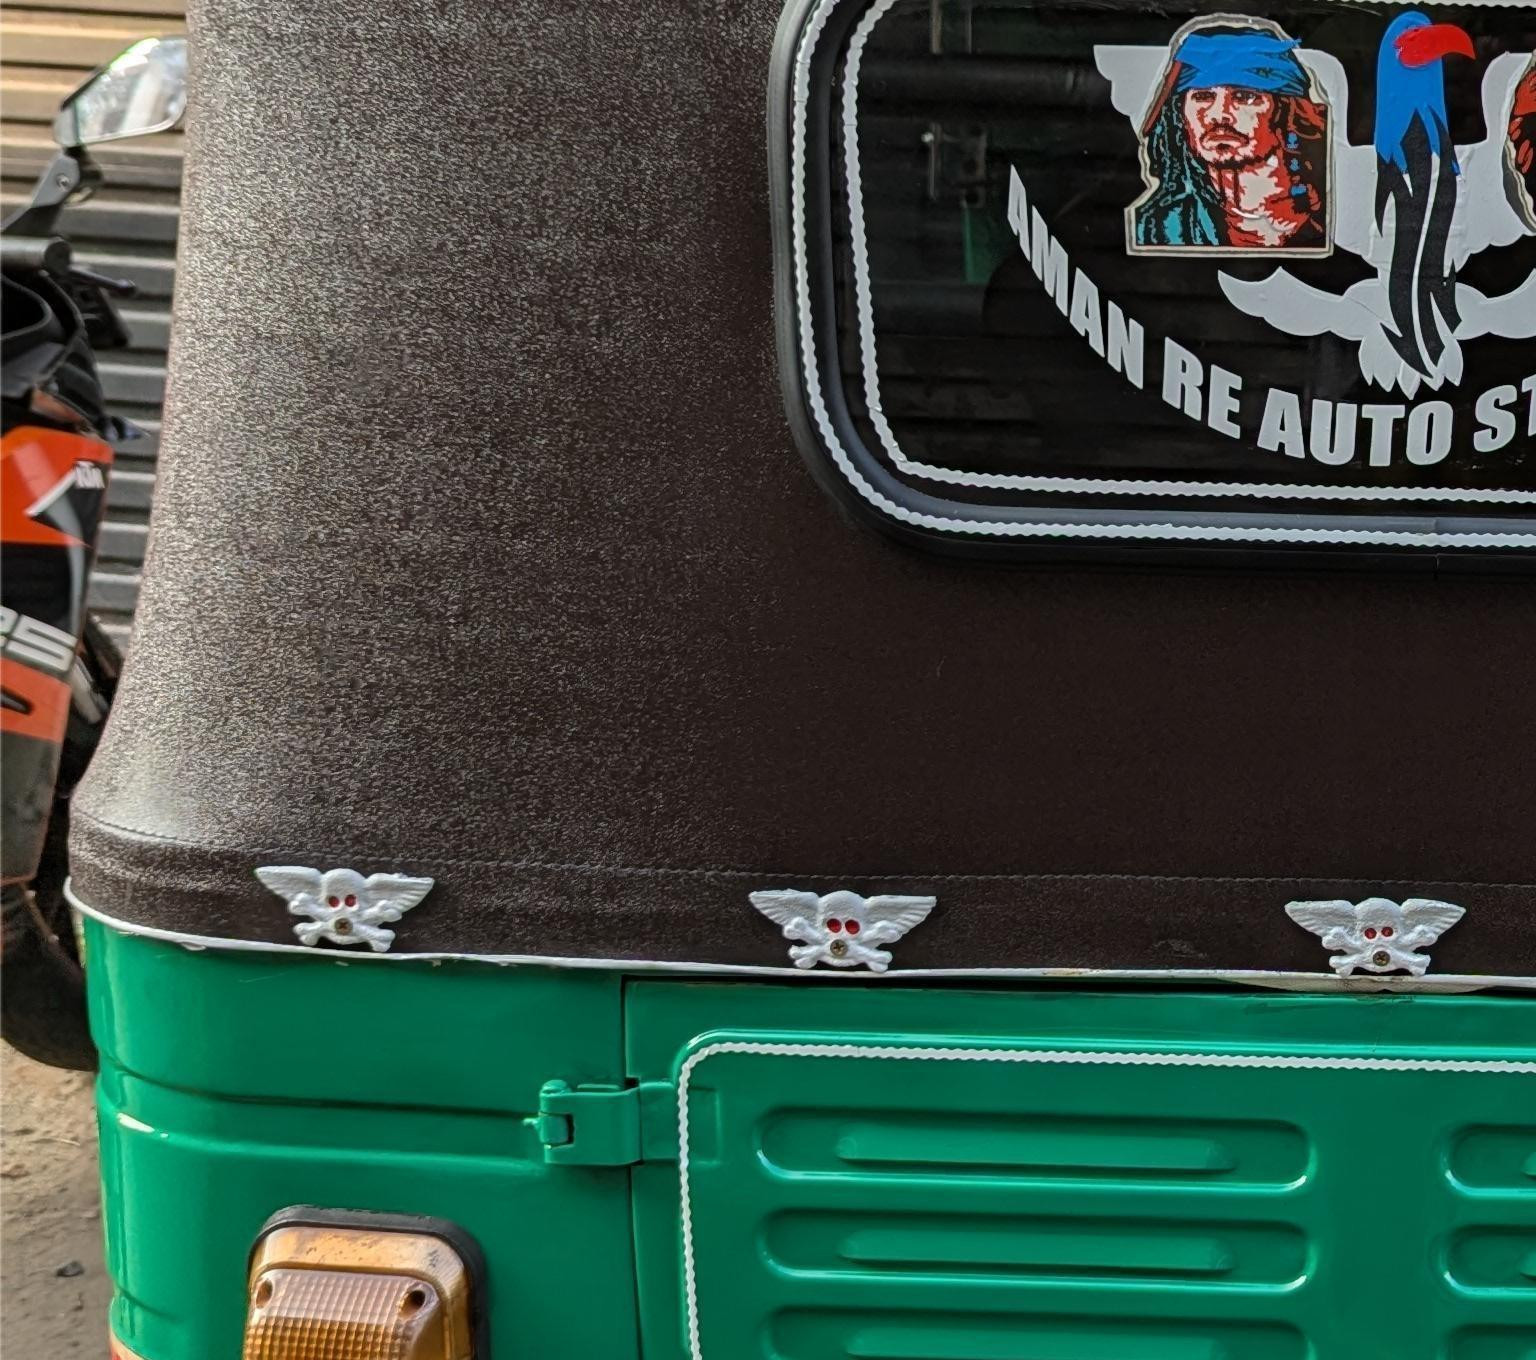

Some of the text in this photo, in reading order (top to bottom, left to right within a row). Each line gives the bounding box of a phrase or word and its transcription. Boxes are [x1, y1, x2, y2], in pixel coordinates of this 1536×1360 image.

[1008, 164, 1145, 390] AMAN
[1161, 336, 1243, 440] RE
[1256, 387, 1454, 467] AUTO
